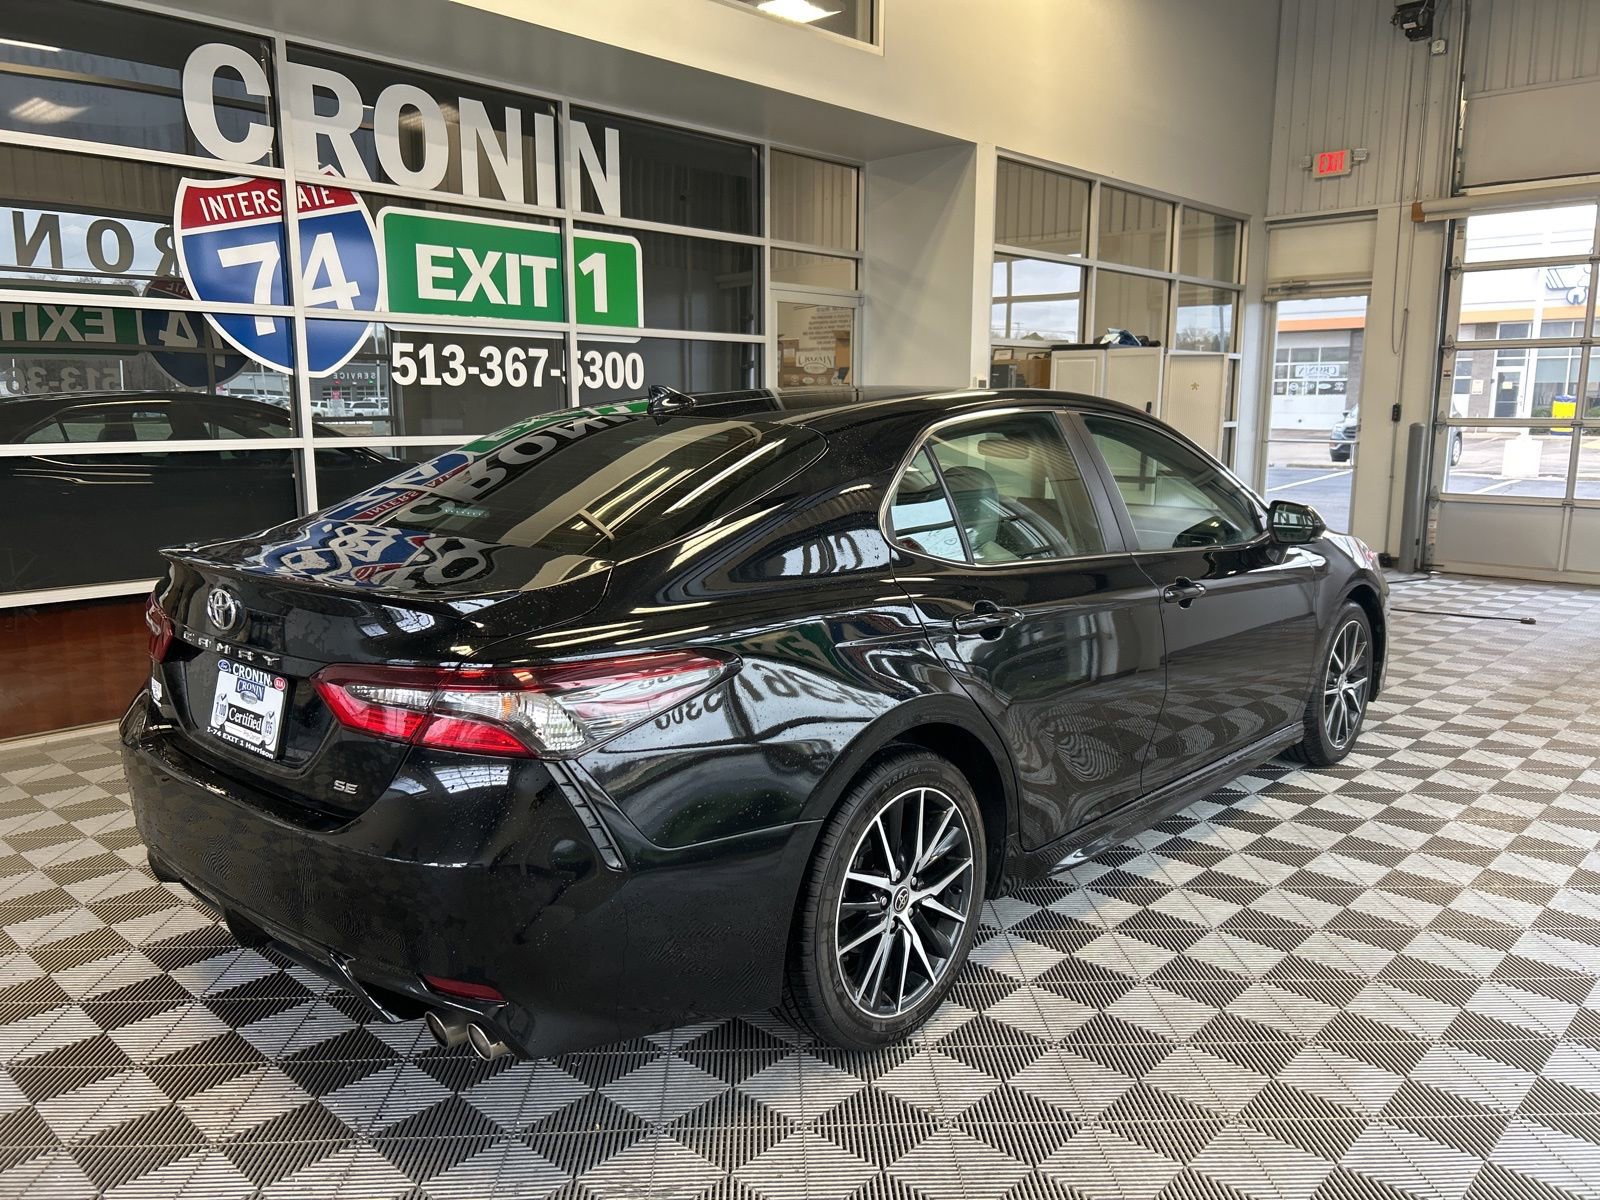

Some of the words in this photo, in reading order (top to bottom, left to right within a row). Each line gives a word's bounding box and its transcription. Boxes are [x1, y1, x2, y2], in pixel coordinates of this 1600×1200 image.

[182, 42, 621, 218] CRONIN
[1318, 151, 1345, 174] EXIT
[199, 184, 335, 222] INTERSATE
[217, 232, 360, 336] 74
[415, 243, 557, 307] EXIT
[578, 252, 608, 313] 1
[183, 631, 280, 667] CAMRY
[232, 662, 271, 687] CRONIN
[237, 680, 264, 701] CRONIN
[229, 707, 262, 731] Certified
[207, 726, 222, 737] I-74
[222, 733, 239, 744] EXIT
[240, 738, 244, 747] 1
[245, 741, 274, 760] Harrison
[333, 779, 359, 795] SE
